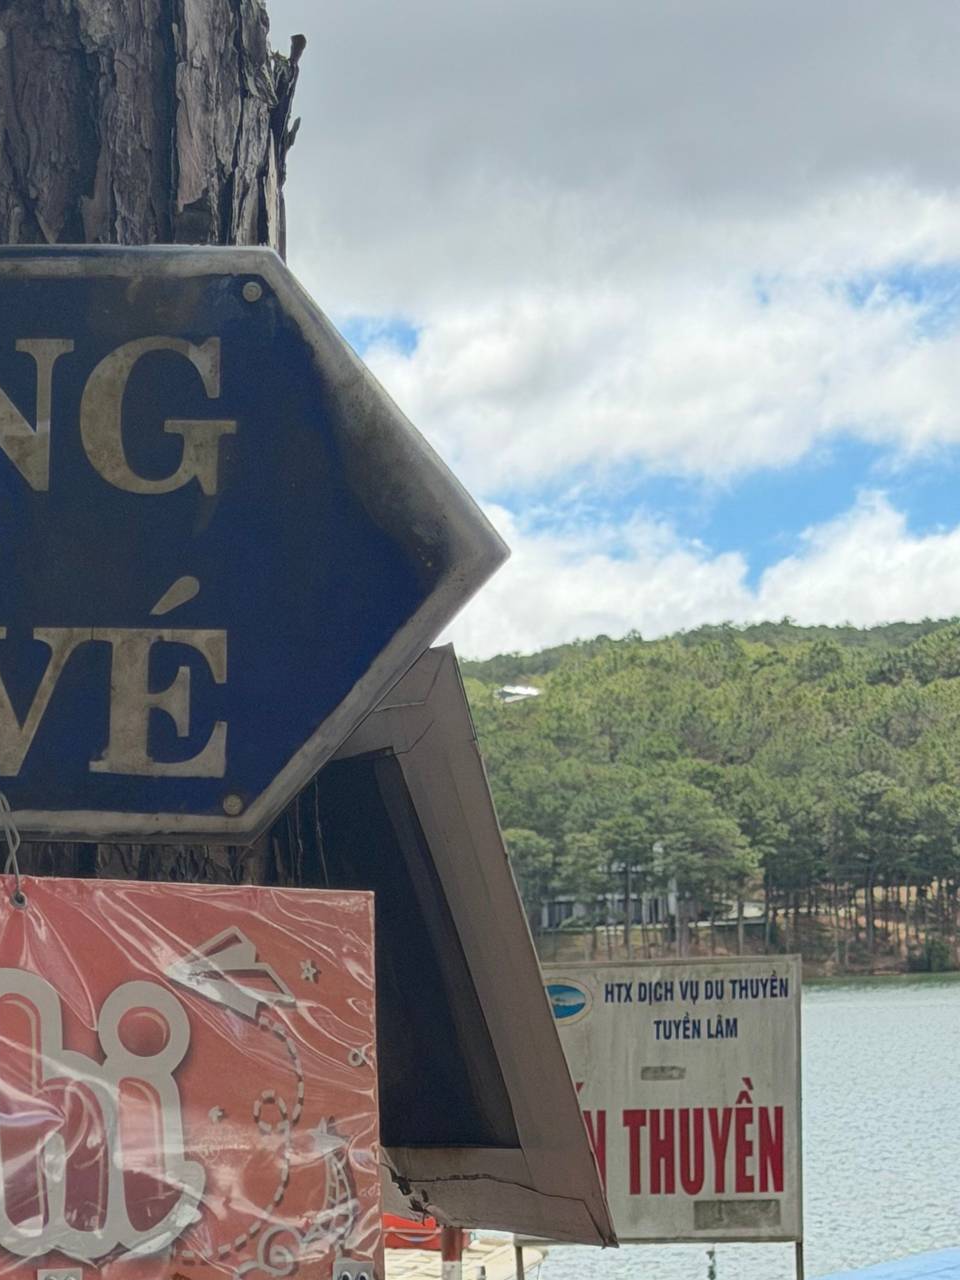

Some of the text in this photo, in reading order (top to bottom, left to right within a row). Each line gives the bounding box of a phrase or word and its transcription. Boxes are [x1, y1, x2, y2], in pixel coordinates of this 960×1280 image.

[604, 969, 789, 1005] HTX DỊCH VỤ DU THUYỀN
[706, 1014, 738, 1039] LÂM
[622, 1077, 784, 1195] THUYỀN
